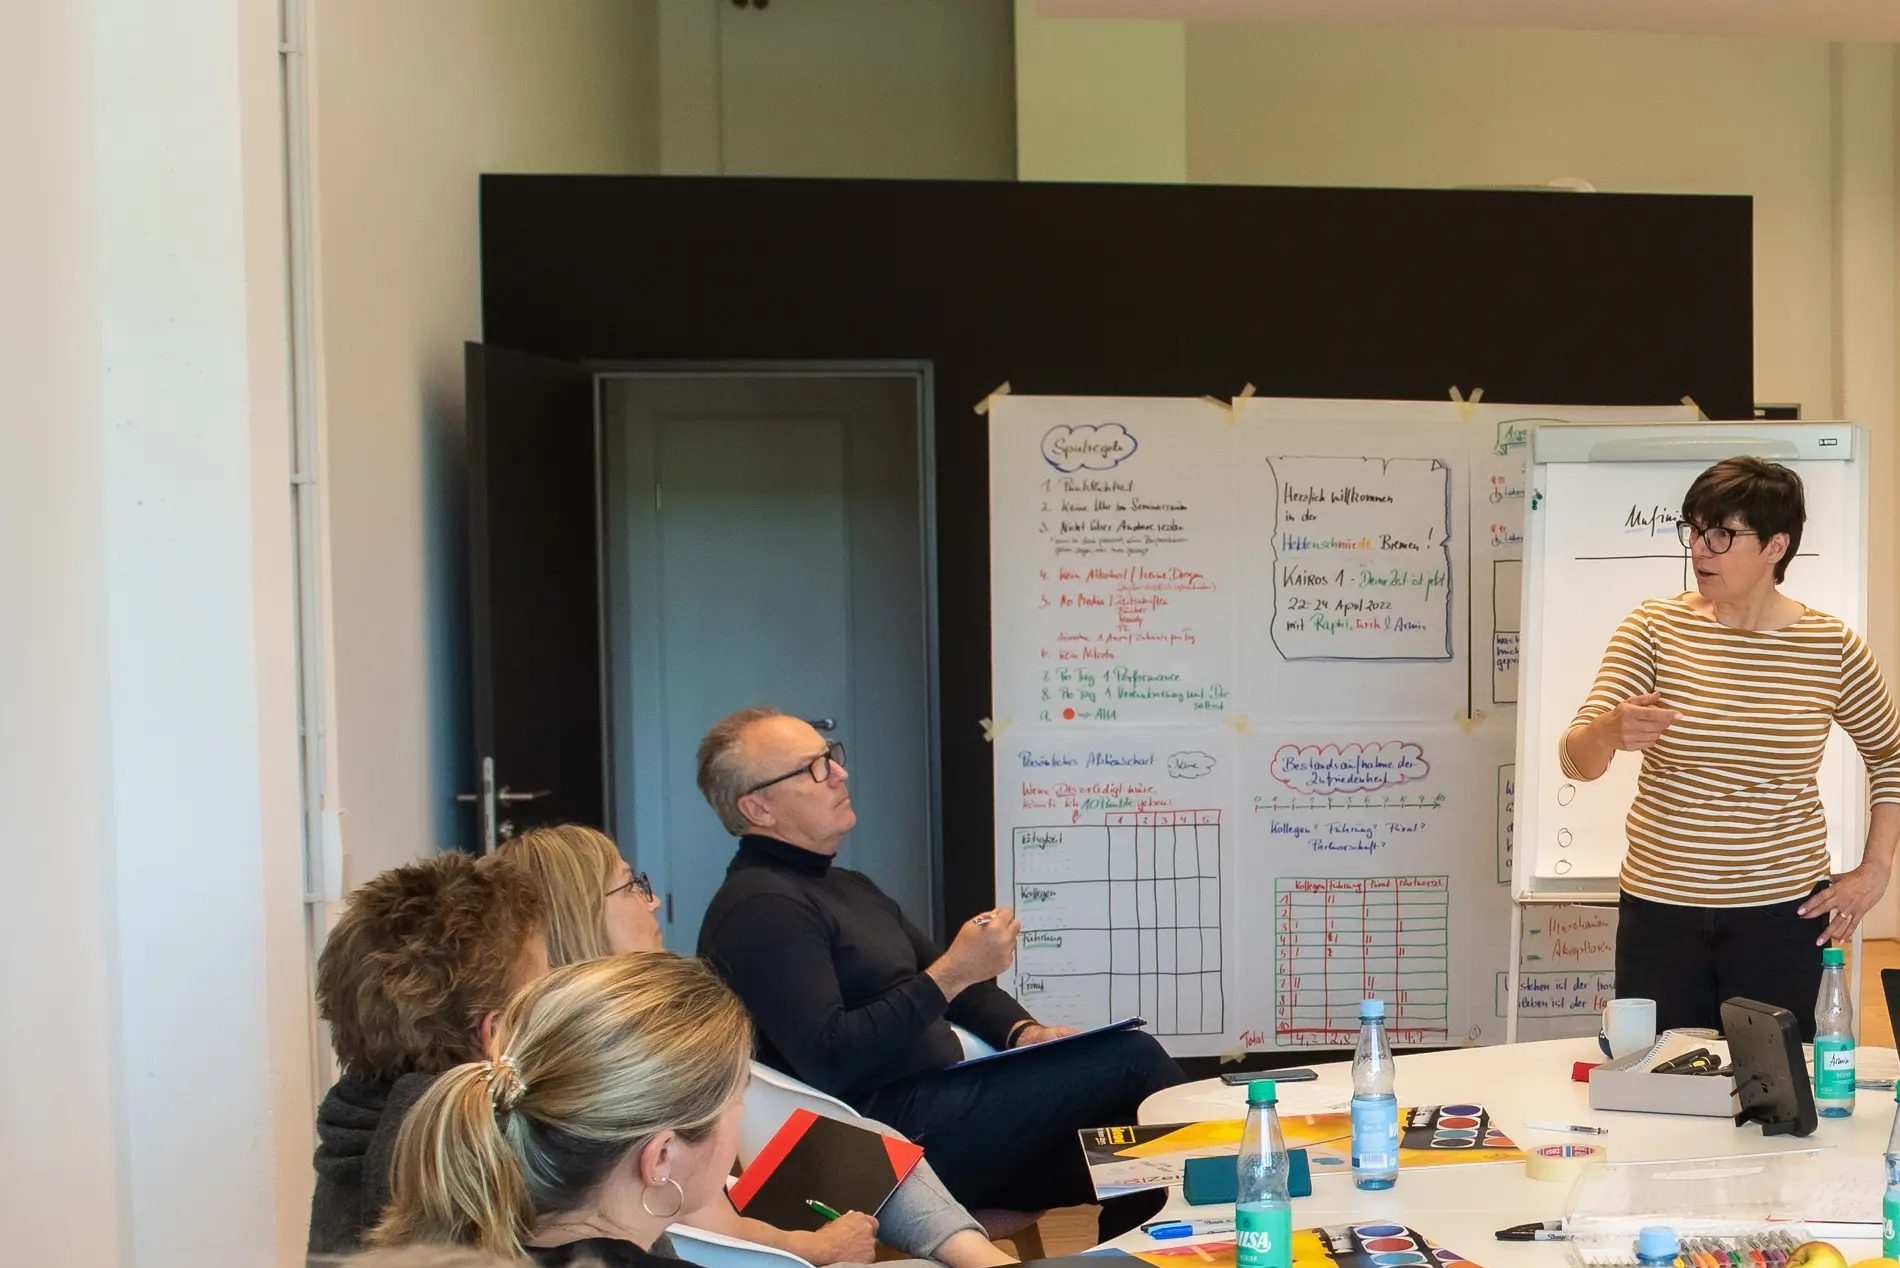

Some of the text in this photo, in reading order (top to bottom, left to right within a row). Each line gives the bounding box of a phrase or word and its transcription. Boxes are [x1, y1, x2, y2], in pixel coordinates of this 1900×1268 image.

[1284, 482, 1325, 504] Herzlich
[1285, 509, 1317, 521] in der
[1359, 569, 1387, 588] Deine
[1335, 599, 1363, 616] April
[1366, 600, 1393, 611] 2022
[1286, 618, 1304, 631] mit
[1282, 755, 1414, 774] Bestandsaufnahme der
[1081, 797, 1099, 810] 10
[1295, 880, 1326, 893] Kollegen
[1556, 978, 1567, 990] ist
[1573, 977, 1587, 991] der
[1552, 998, 1564, 1008] ist
[1570, 996, 1587, 1009] der
[1240, 1033, 1265, 1048] Total
